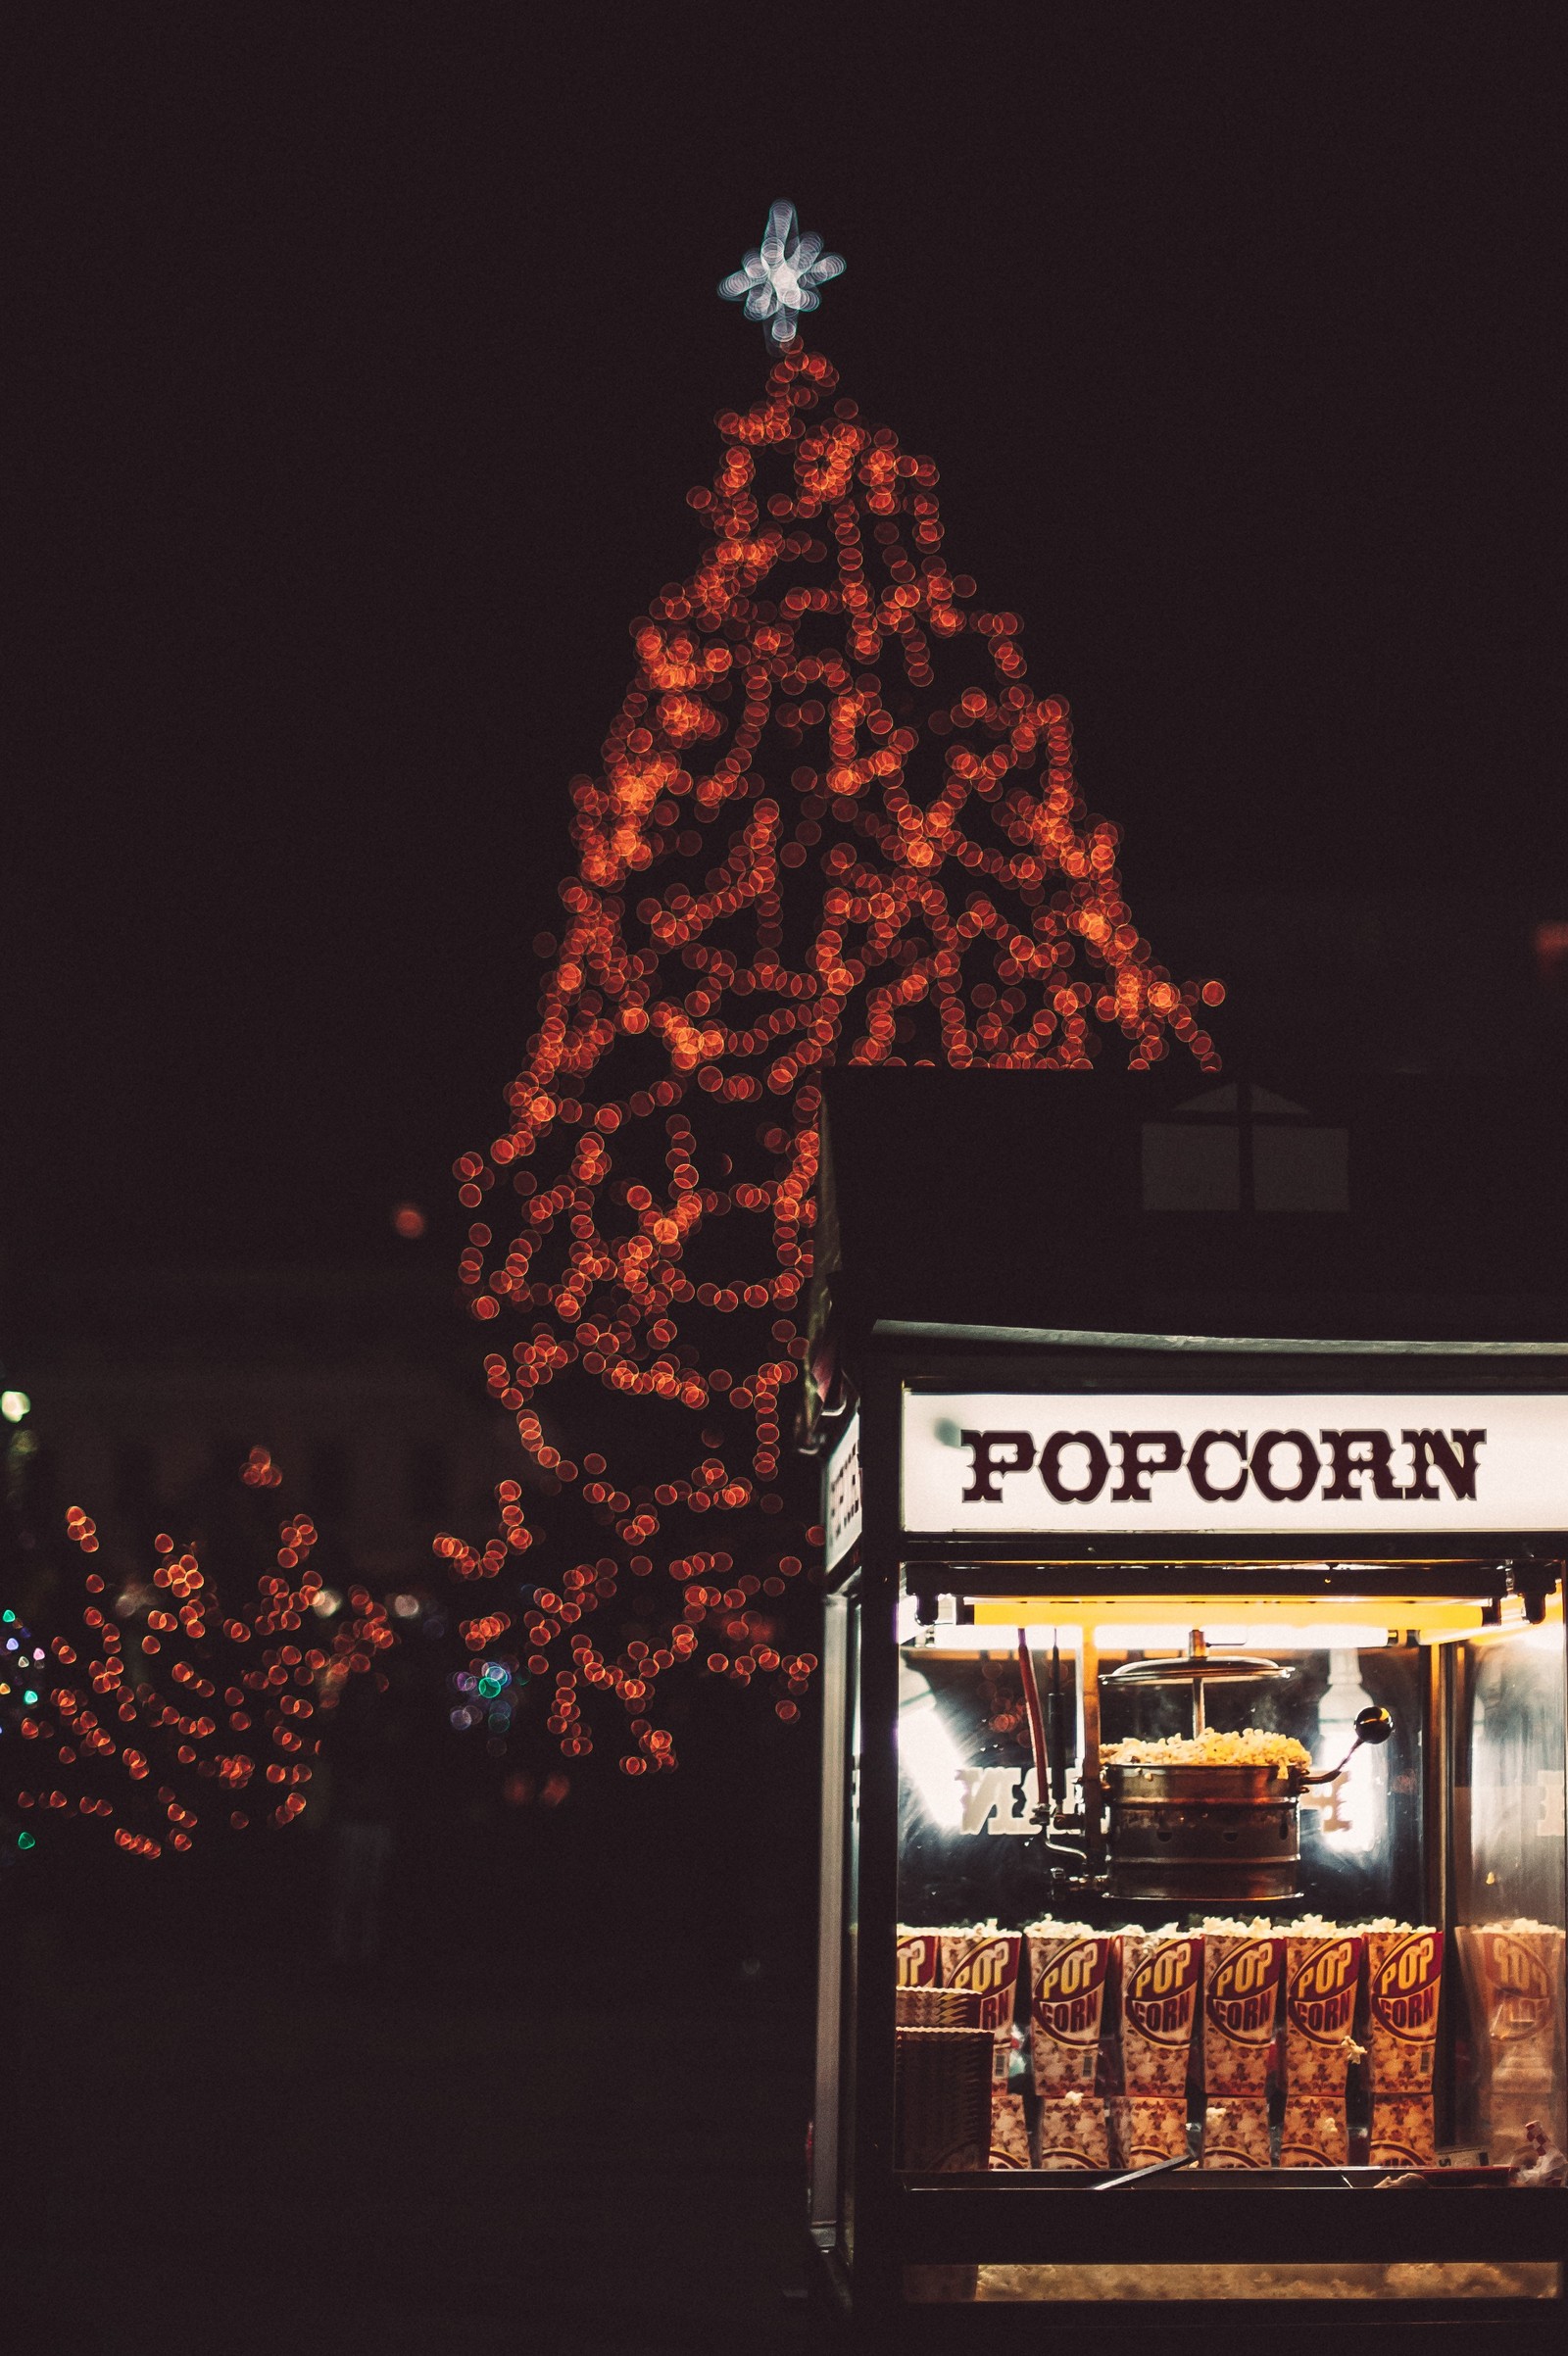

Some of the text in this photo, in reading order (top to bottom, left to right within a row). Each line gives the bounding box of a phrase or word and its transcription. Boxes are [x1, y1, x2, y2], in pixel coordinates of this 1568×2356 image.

[960, 1428, 1488, 1504] POPCORN
[954, 1940, 1009, 1992] POP
[1043, 1942, 1098, 1999] POP
[1135, 1942, 1191, 1998] POP
[1216, 1941, 1272, 1997] POP
[1298, 1941, 1352, 1998] POP
[1381, 1937, 1434, 1995] POP
[1042, 1989, 1098, 2033] CORN
[1134, 1990, 1191, 2033] CORN
[1215, 1990, 1271, 2032] CORN
[1297, 1989, 1351, 2033] CORN
[1381, 1986, 1434, 2029] CORN
